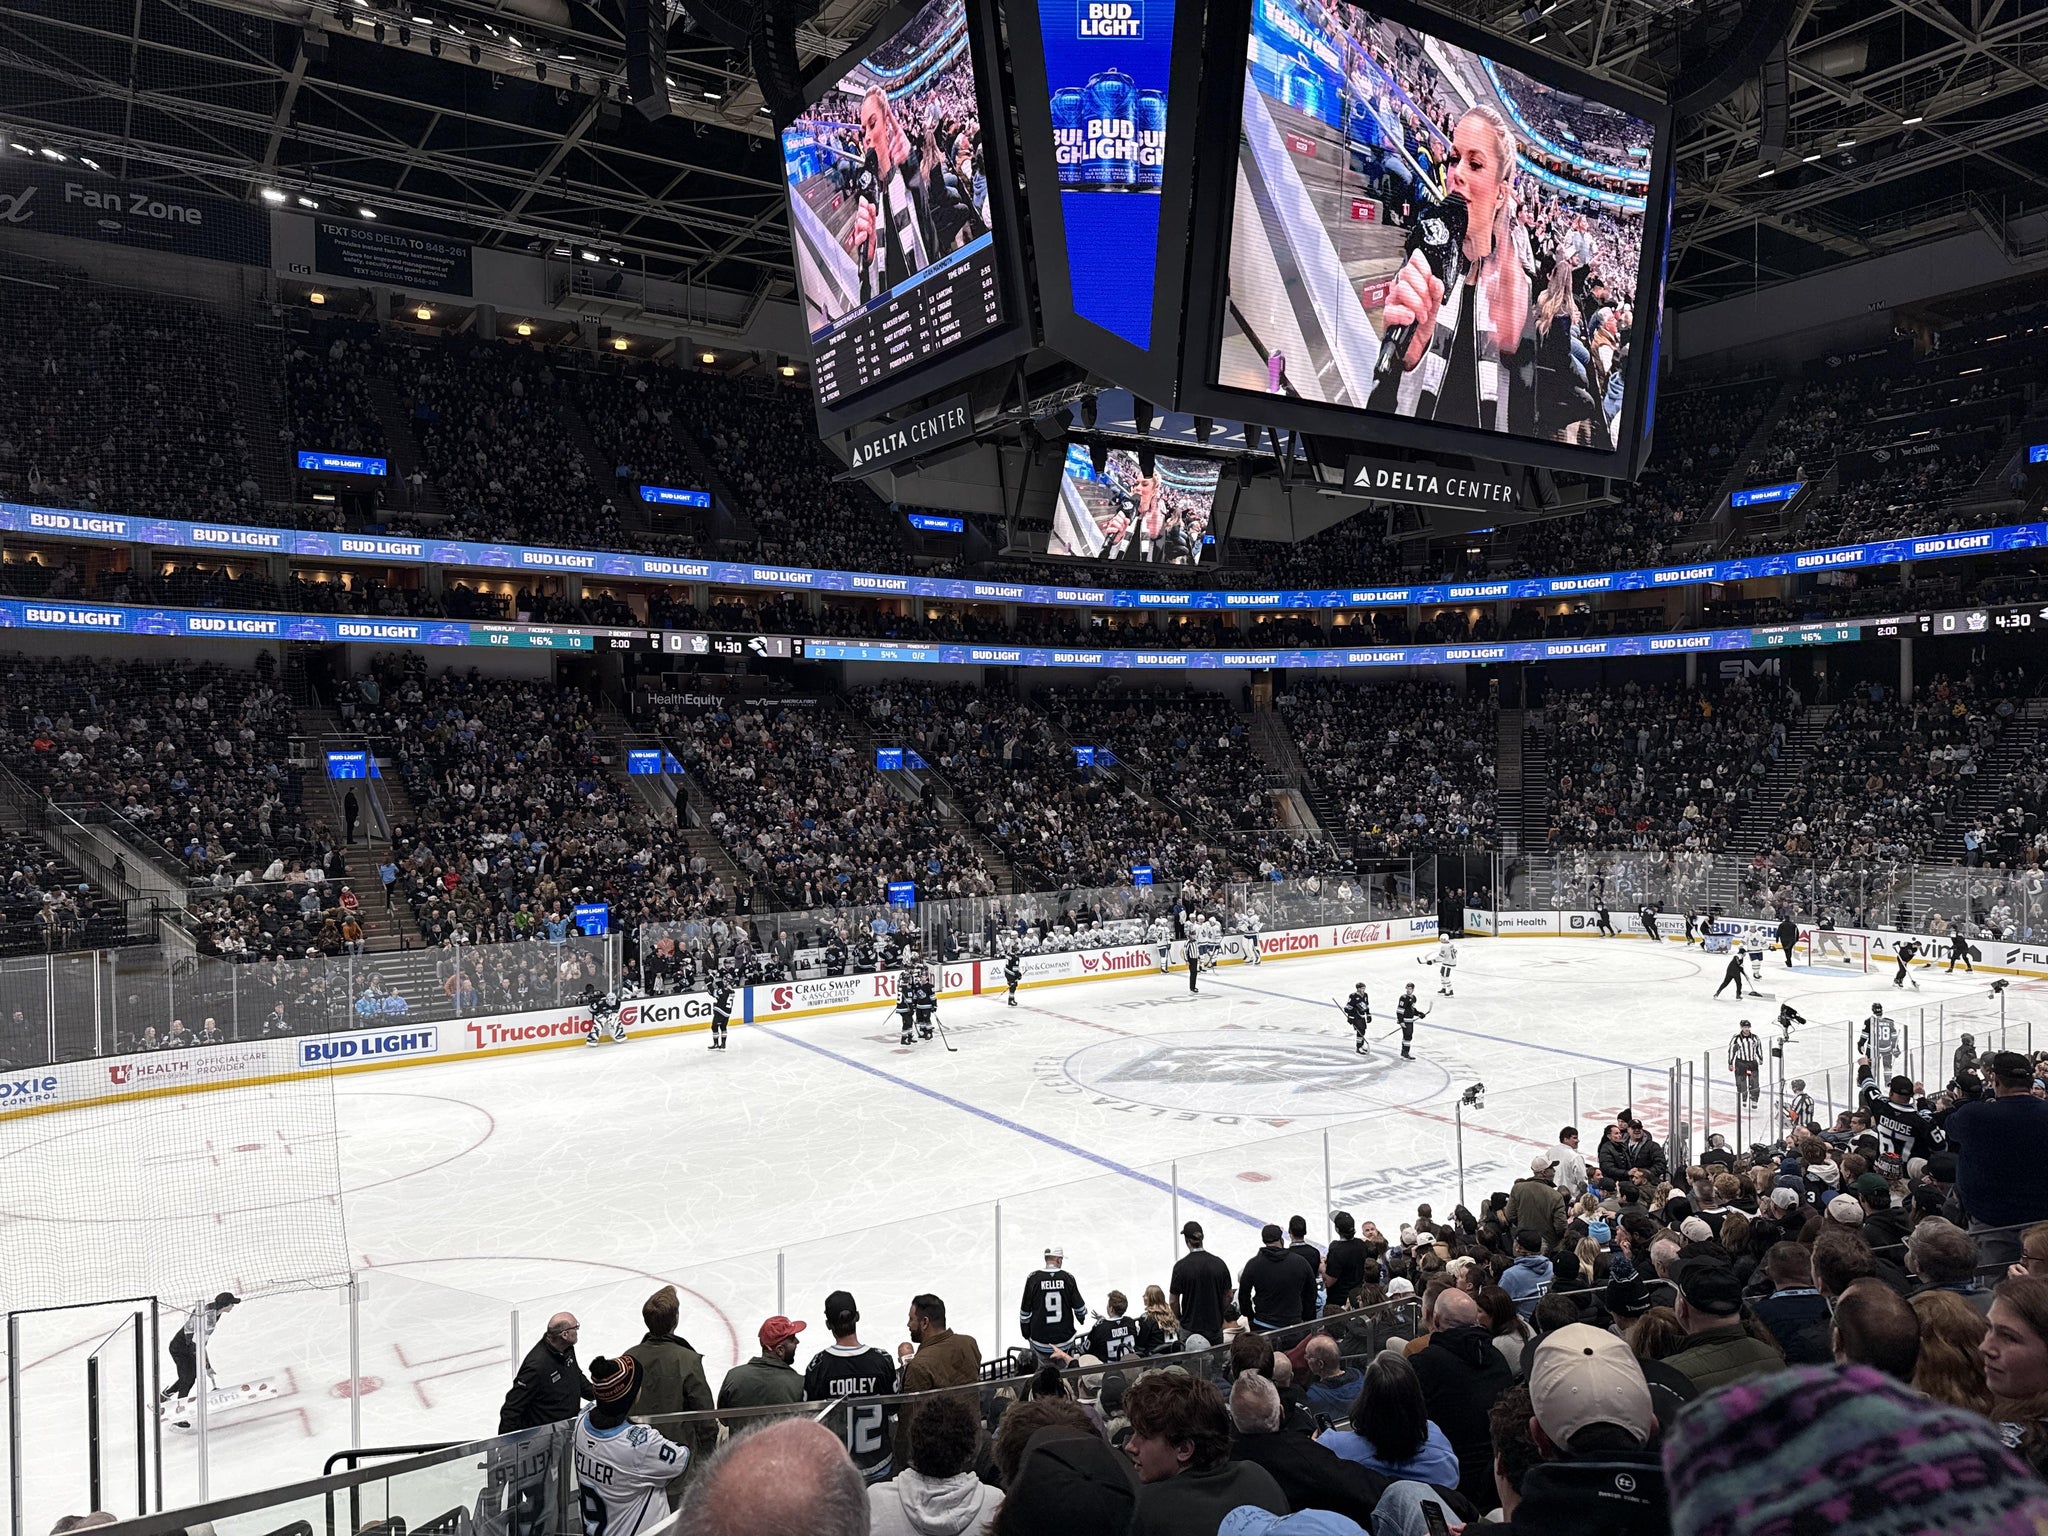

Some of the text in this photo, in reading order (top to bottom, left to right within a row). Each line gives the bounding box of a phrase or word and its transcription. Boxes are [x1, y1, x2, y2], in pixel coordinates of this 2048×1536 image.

[1089, 4, 1132, 20] BUD
[1081, 20, 1140, 36] LIGHT
[1088, 119, 1134, 140] BUD
[1082, 139, 1140, 161] LIGHT
[64, 182, 122, 211] Fan
[129, 194, 202, 224] Zone
[321, 224, 467, 258] TEXT SOS DELTA TO 848-261
[864, 407, 966, 462] DELTA CENTER
[1376, 470, 1512, 502] DELTA CENTER
[30, 513, 126, 534] BUD LIGHT
[193, 529, 280, 546] BUD LIGHT
[1914, 535, 1990, 554] BUD LIGHT
[342, 540, 422, 556] BUD LIGHT
[523, 552, 594, 568] BUD LIGHT
[1797, 550, 1864, 568] BUD LIGHT
[644, 562, 708, 576] BUD LIGHT
[1654, 568, 1714, 582] BUD LIGHT
[754, 570, 812, 583] BUD LIGHT
[854, 578, 906, 590] BUD LIGHT
[1551, 578, 1610, 590] BUD LIGHT
[975, 586, 1022, 598] BUD LIGHT
[1057, 591, 1104, 602] BUD LIGHT
[1140, 594, 1190, 604] BUD LIGHT
[1352, 592, 1408, 602] BUD LIGHT
[1450, 586, 1508, 598] BUD LIGHT
[1227, 595, 1280, 604] BUD LIGHT
[26, 609, 122, 628] BUD LIGHT
[1943, 616, 1955, 630] 0
[1995, 614, 2030, 628] 4:30
[189, 618, 277, 634] BUD LIGHT
[338, 624, 418, 639] BUD LIGHT
[1878, 626, 1898, 636] 2:00
[1922, 623, 1928, 632] 6
[490, 635, 581, 647] 0/2 46% 10
[610, 640, 630, 648] 2:00
[652, 640, 658, 648] 6
[671, 636, 682, 650] 0
[1651, 636, 1710, 650] BUD LIGHT
[1768, 630, 1848, 644] 0/2 46% 10
[714, 642, 742, 654] 4:30
[776, 640, 782, 654] 1
[816, 648, 826, 656] 23
[912, 652, 925, 660] 0/2
[1446, 648, 1504, 660] BUD LIGHT
[1548, 643, 1607, 656] BUD LIGHT
[972, 651, 1020, 660] BUD LIGHT
[1054, 654, 1101, 663] BUD LIGHT
[1137, 656, 1186, 664] BUD LIGHT
[1224, 656, 1276, 664] BUD LIGHT
[1349, 653, 1404, 662] BUD LIGHT
[648, 694, 725, 707] HealthEquity
[1411, 918, 1438, 932] Layton
[1486, 917, 1547, 926] Nomi Health
[1712, 923, 1742, 934] BUD
[1260, 932, 1319, 953] verizon
[1102, 950, 1152, 970] Smith's
[795, 980, 860, 994] CRAIG SWAPP
[874, 974, 896, 997] Ri
[809, 988, 854, 1000] ASSOCIATES
[640, 1004, 680, 1024] Ken
[486, 1016, 594, 1043] Trucordia
[304, 1032, 433, 1062] BUD LIGHT
[196, 1052, 266, 1066] OFFICIAL CARE
[136, 1061, 189, 1076] HEALTH
[196, 1062, 245, 1074] PROVIDER
[0, 1076, 58, 1099] oxie
[2, 1092, 58, 1106] CONTROL
[1880, 1114, 1912, 1136] CROUSE
[1876, 1123, 1916, 1162] 67
[1806, 1191, 1816, 1203] 3
[1040, 1280, 1064, 1290] KELLER
[1045, 1291, 1062, 1324] 9
[830, 1377, 876, 1396] COOLEY
[660, 1444, 677, 1464] 9
[576, 1452, 613, 1486] ELLER
